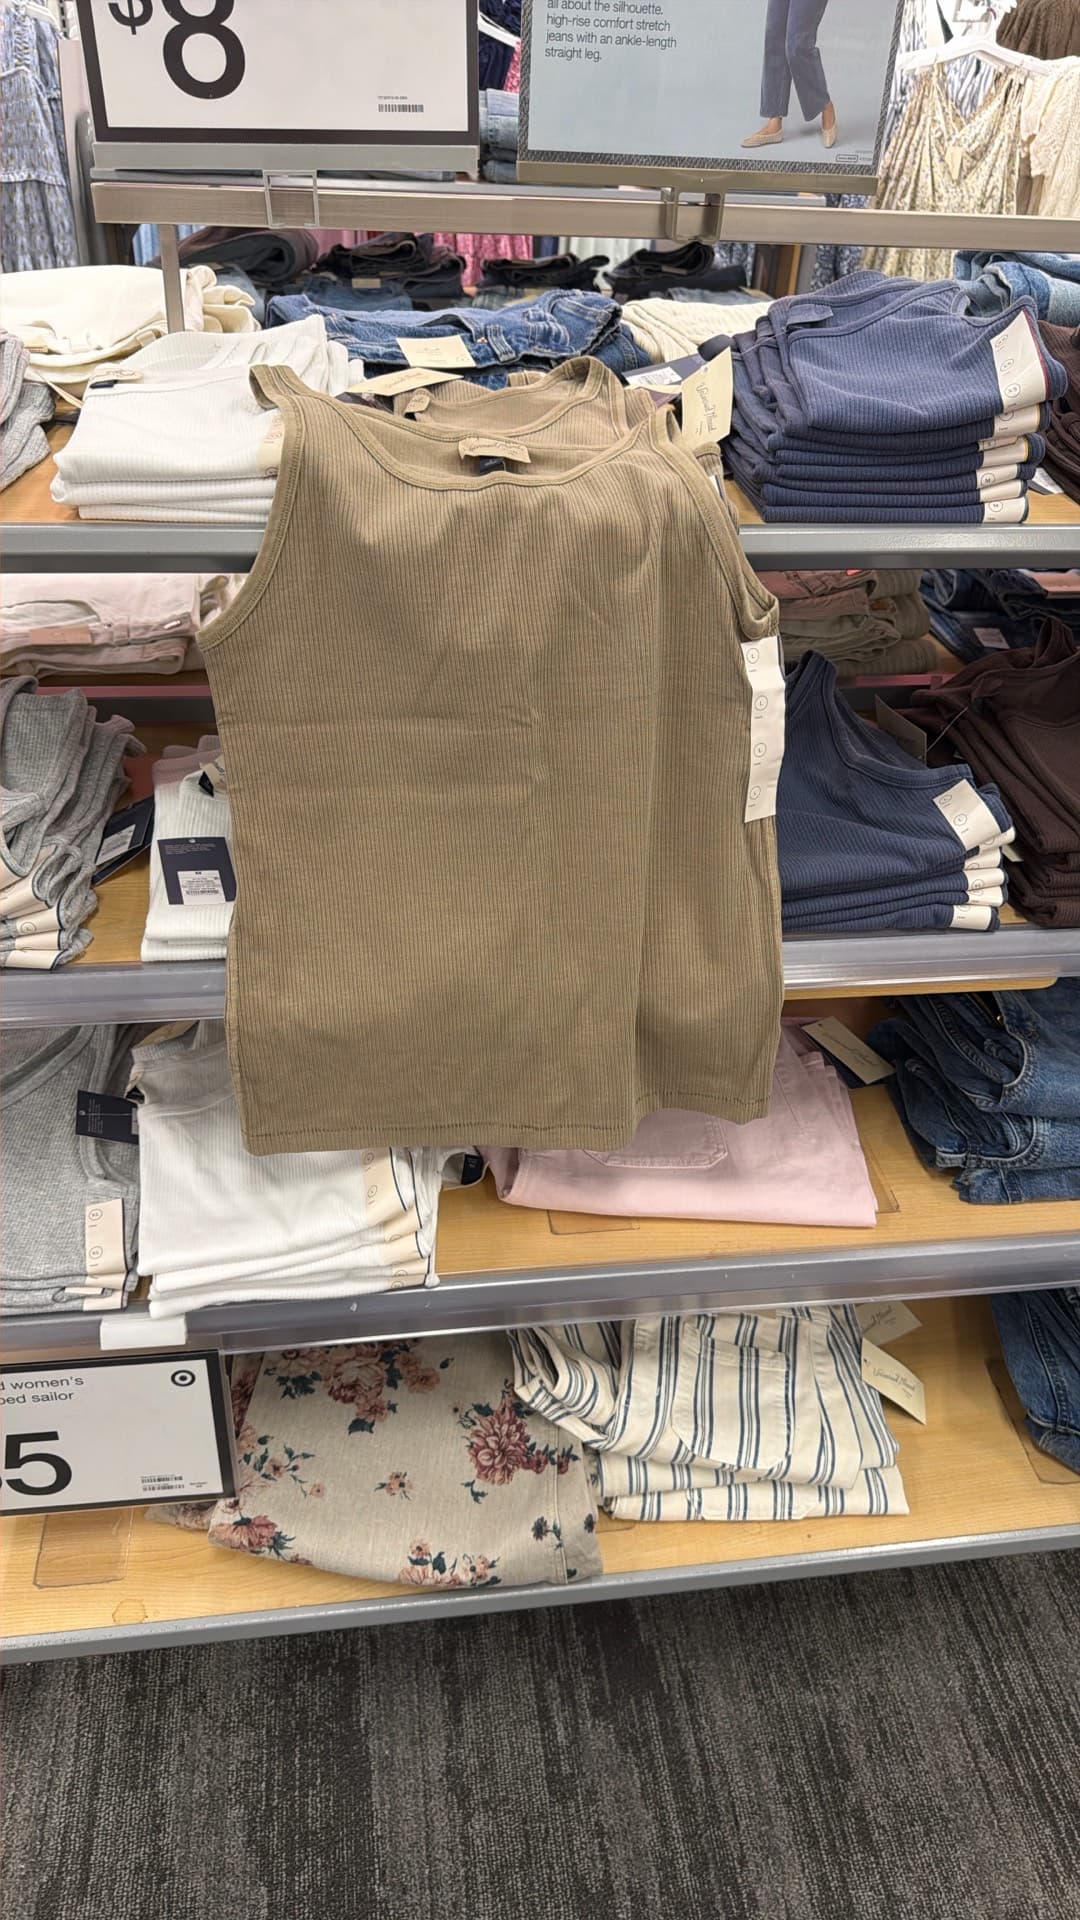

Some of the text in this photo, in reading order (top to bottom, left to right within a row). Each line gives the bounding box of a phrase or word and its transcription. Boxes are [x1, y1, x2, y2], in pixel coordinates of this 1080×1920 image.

[547, 0, 664, 15] all about the silhouette.
[546, 13, 671, 32] high-rise comfort stretch
[545, 29, 677, 50] jeans with an ankle-length
[544, 46, 602, 63] straight leg.
[10, 1376, 84, 1390] women's
[31, 1391, 74, 1403] sailor
[0, 1430, 73, 1497] 5
